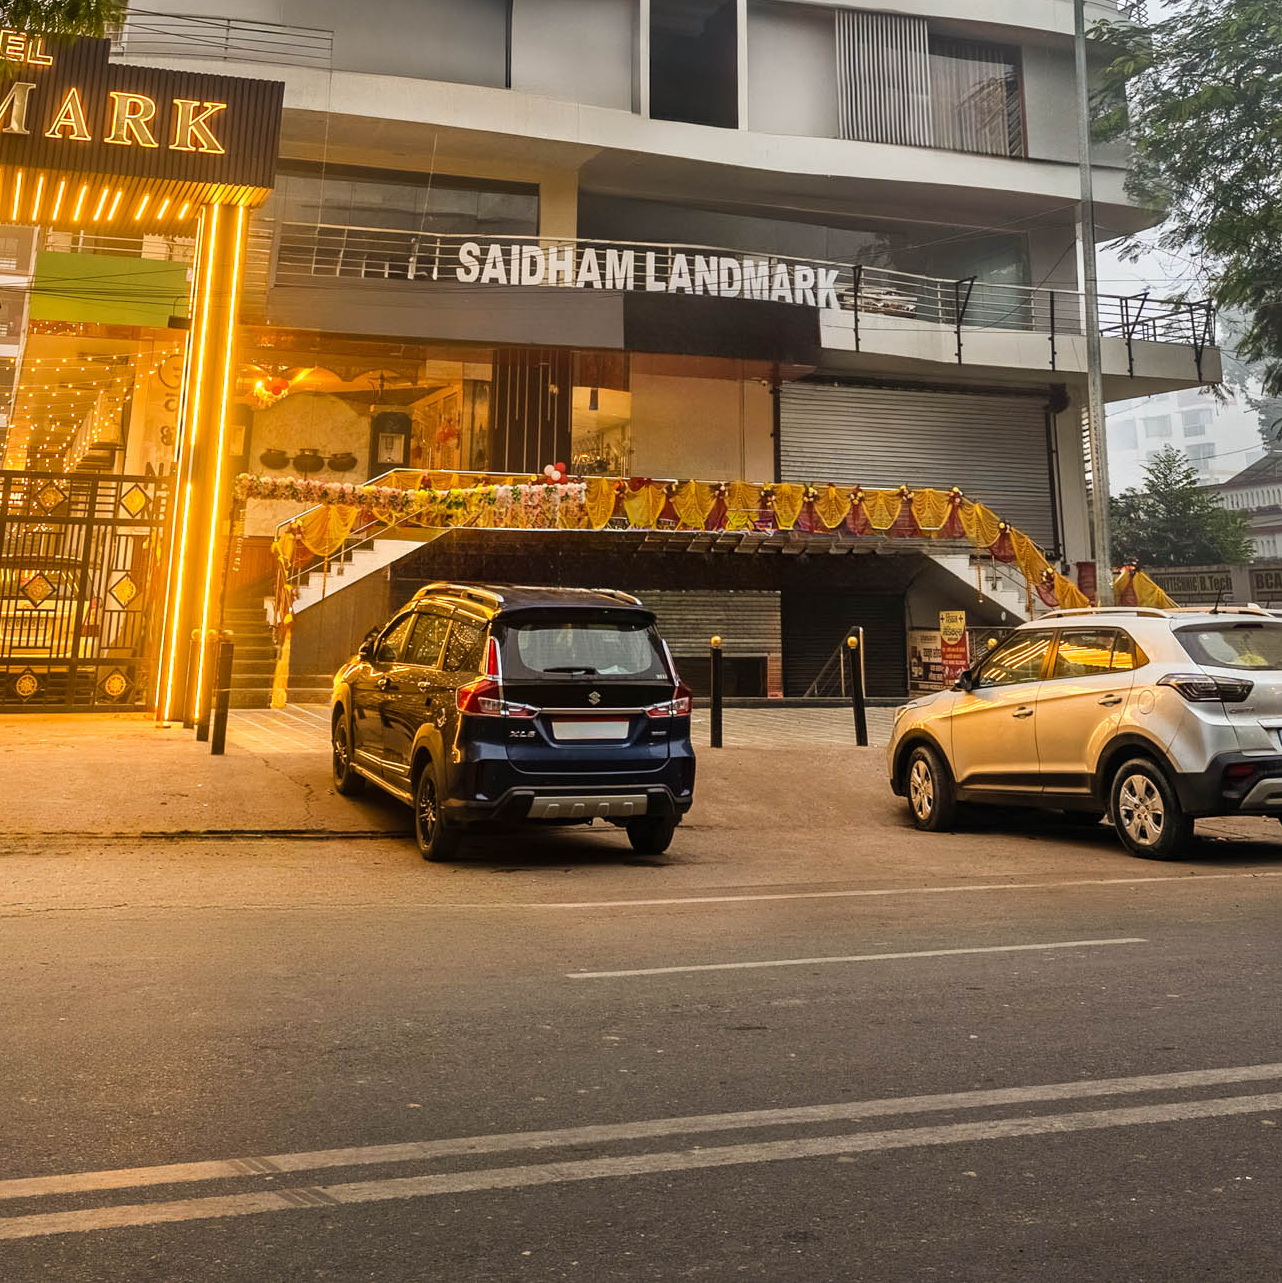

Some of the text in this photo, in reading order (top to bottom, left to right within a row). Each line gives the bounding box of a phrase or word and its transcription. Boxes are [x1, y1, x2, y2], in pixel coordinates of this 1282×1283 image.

[456, 241, 841, 309] SAIDHAM LANDMARK
[1255, 573, 1282, 590] BCA
